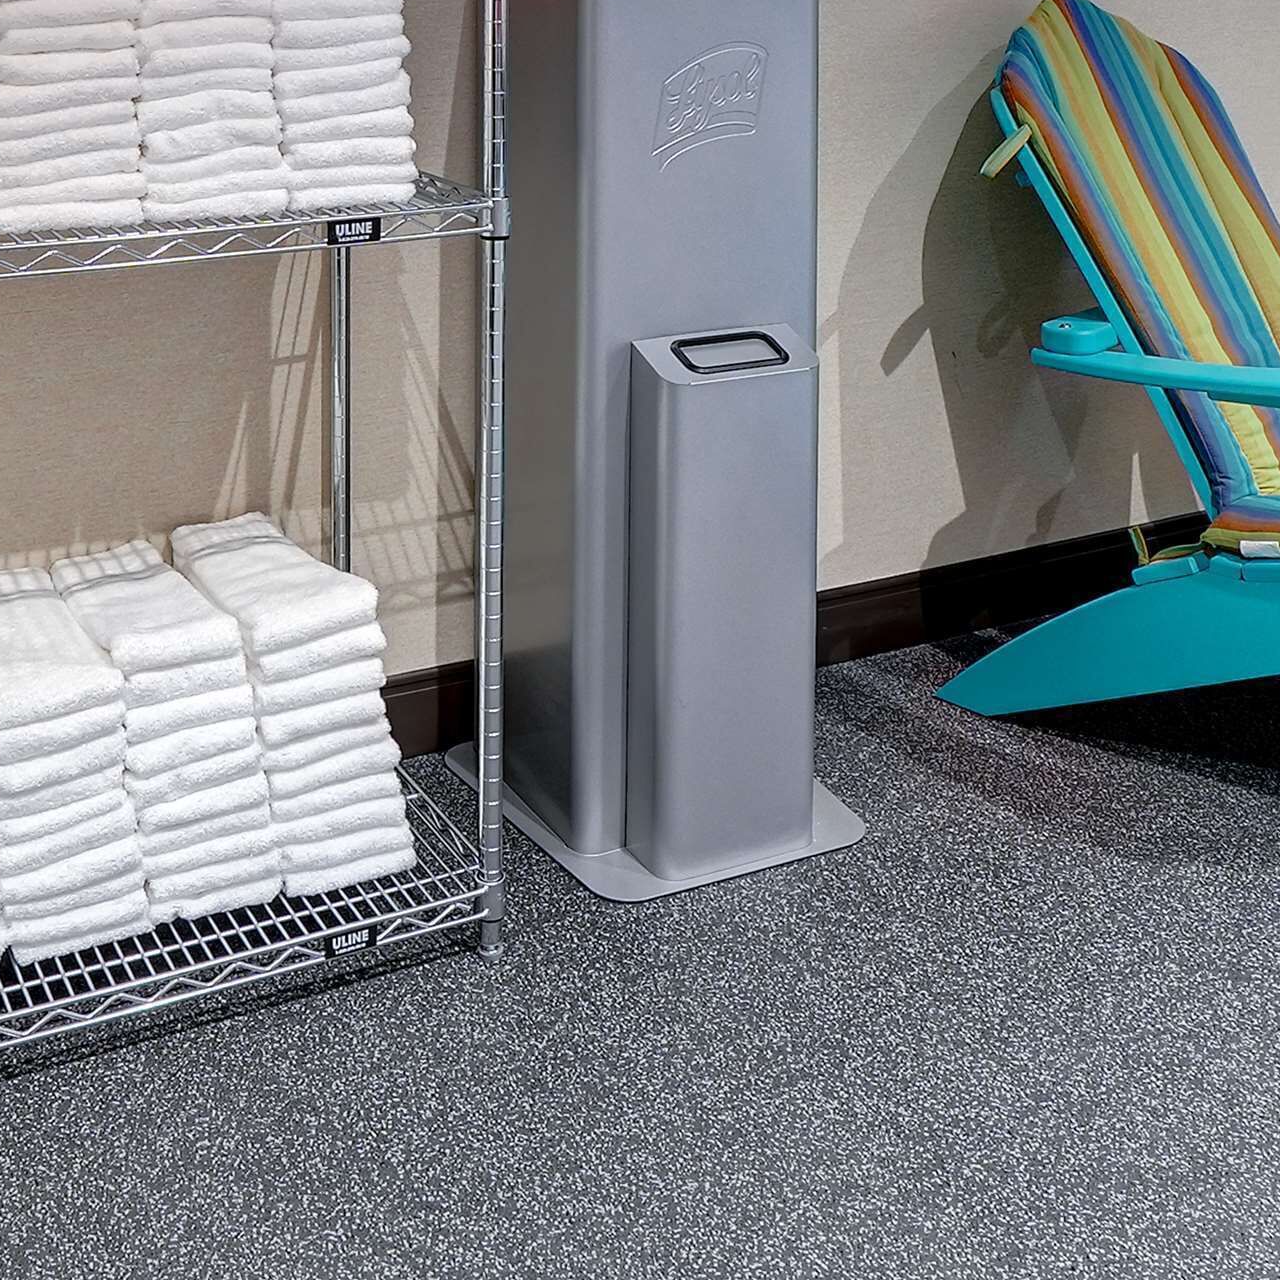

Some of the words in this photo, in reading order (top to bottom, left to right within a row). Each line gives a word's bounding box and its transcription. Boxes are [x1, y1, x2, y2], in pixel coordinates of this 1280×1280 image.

[664, 52, 761, 132] Lysol
[335, 222, 373, 236] ULINE
[332, 929, 369, 950] ULINE
